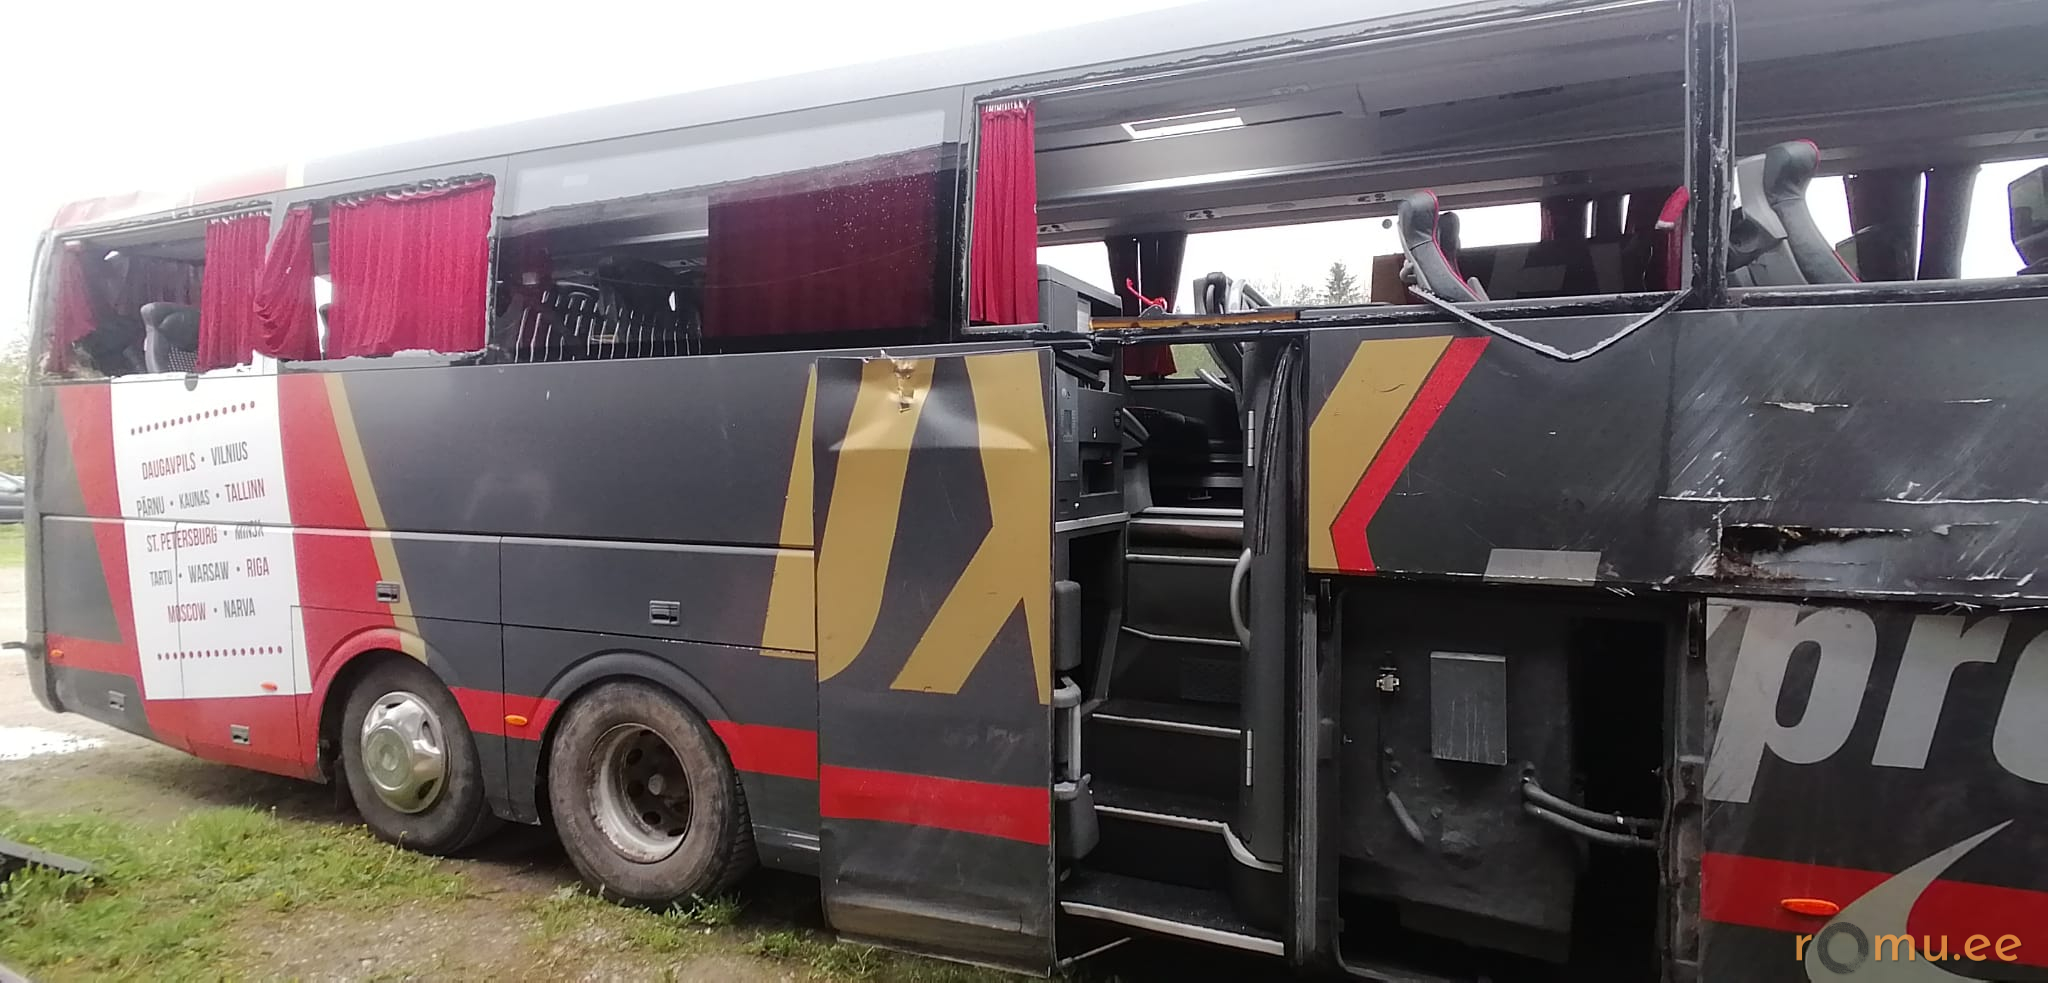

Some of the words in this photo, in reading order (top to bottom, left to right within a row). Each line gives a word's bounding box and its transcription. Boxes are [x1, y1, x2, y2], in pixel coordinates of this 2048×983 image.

[142, 452, 196, 480] DAUGAVPILS
[211, 441, 248, 466] VILNIUS
[179, 489, 210, 509] KAUNAS
[225, 478, 266, 503] TALLINN
[161, 526, 218, 551] PETERSBURG
[150, 570, 173, 586] TARTU
[188, 561, 229, 583] WARSAW
[247, 557, 270, 577] RIGA
[168, 602, 206, 623] MOSCOW
[224, 597, 256, 618] NARVA
